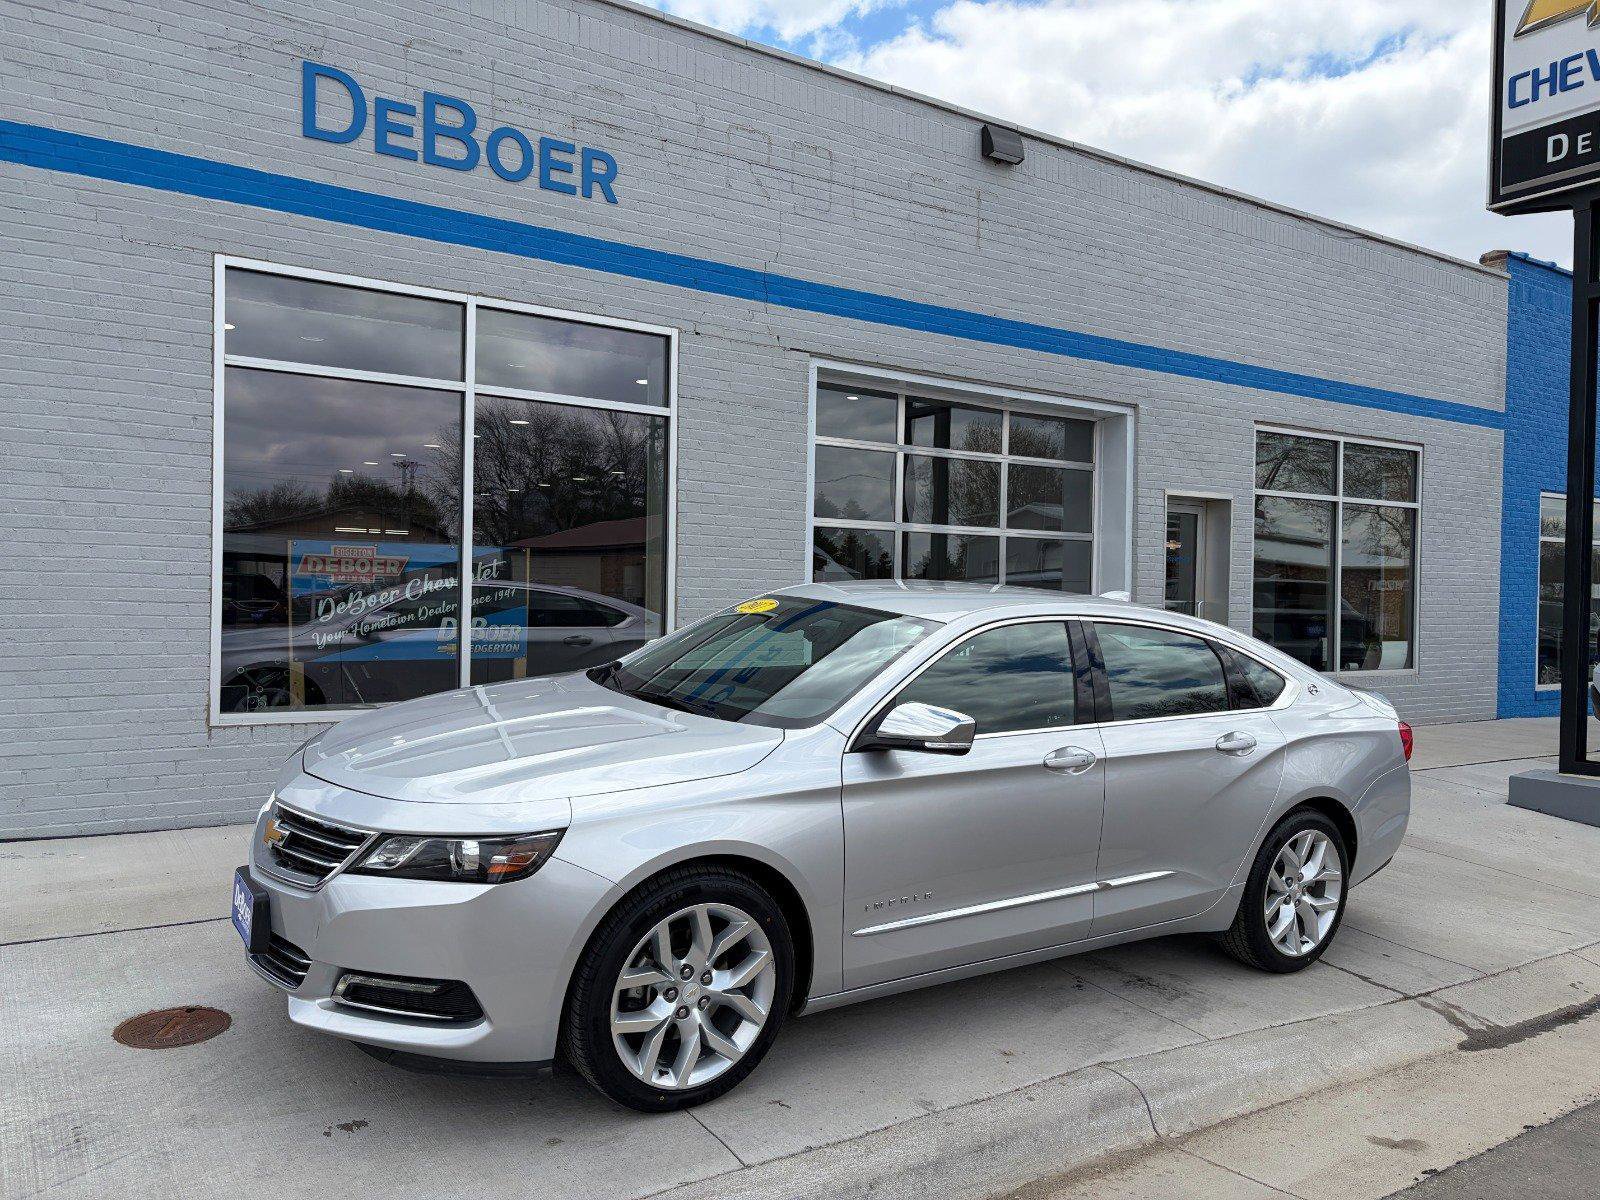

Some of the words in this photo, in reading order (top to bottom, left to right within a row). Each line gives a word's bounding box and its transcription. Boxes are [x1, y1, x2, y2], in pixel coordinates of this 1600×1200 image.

[307, 558, 400, 574] DEBOER
[317, 590, 400, 622] DeBoer
[405, 558, 507, 601] Chevlet
[312, 628, 349, 650] Your
[351, 612, 416, 638] Hometown
[418, 600, 458, 622] Dealer
[437, 616, 522, 642] DBOER
